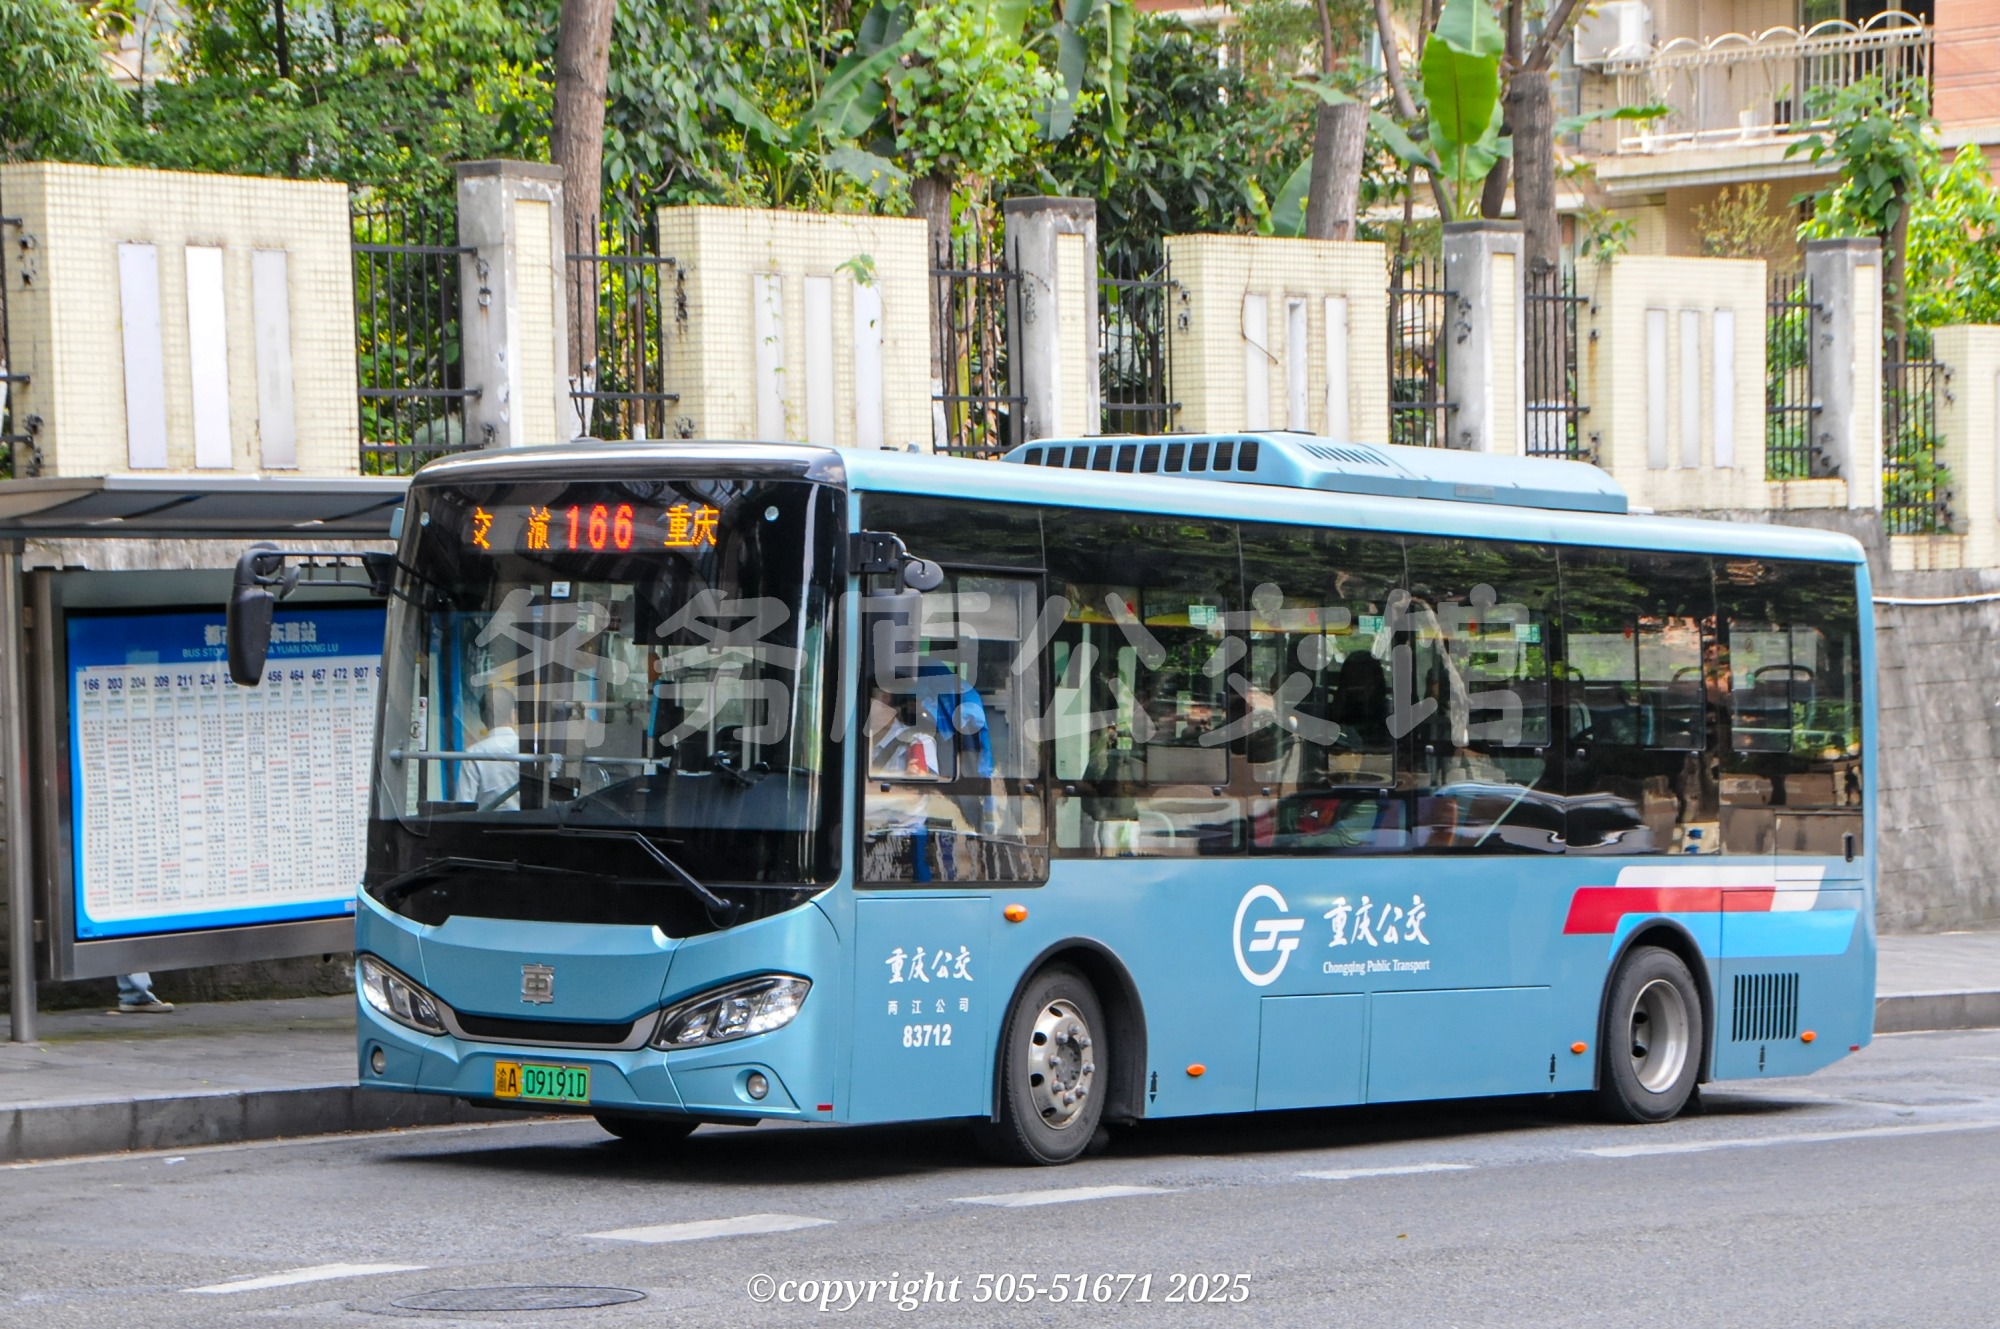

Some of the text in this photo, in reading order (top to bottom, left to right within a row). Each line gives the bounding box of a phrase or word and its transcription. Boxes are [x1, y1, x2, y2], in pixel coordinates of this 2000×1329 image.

[565, 504, 634, 550] 166
[663, 503, 720, 547] 重庆
[182, 649, 201, 658] BUS
[202, 647, 226, 657] STOP
[276, 644, 301, 654] YUAN
[301, 643, 325, 653] DONG
[327, 643, 339, 652] LU
[84, 679, 100, 691] 166
[107, 677, 123, 690] 203
[130, 677, 146, 689] 204
[154, 675, 170, 688] 209
[176, 675, 194, 687] 211
[200, 673, 216, 686] 234
[267, 670, 283, 682] 456
[289, 669, 304, 681] 464
[311, 668, 326, 680] 467
[333, 667, 348, 679] 472
[354, 667, 369, 679] 807
[1323, 895, 1430, 948] 重庆公交
[885, 945, 974, 984] 重庆公交
[1323, 959, 1430, 976] Chongqing Public Transport
[887, 997, 970, 1016] 两江公司
[902, 1023, 952, 1048] 83712
